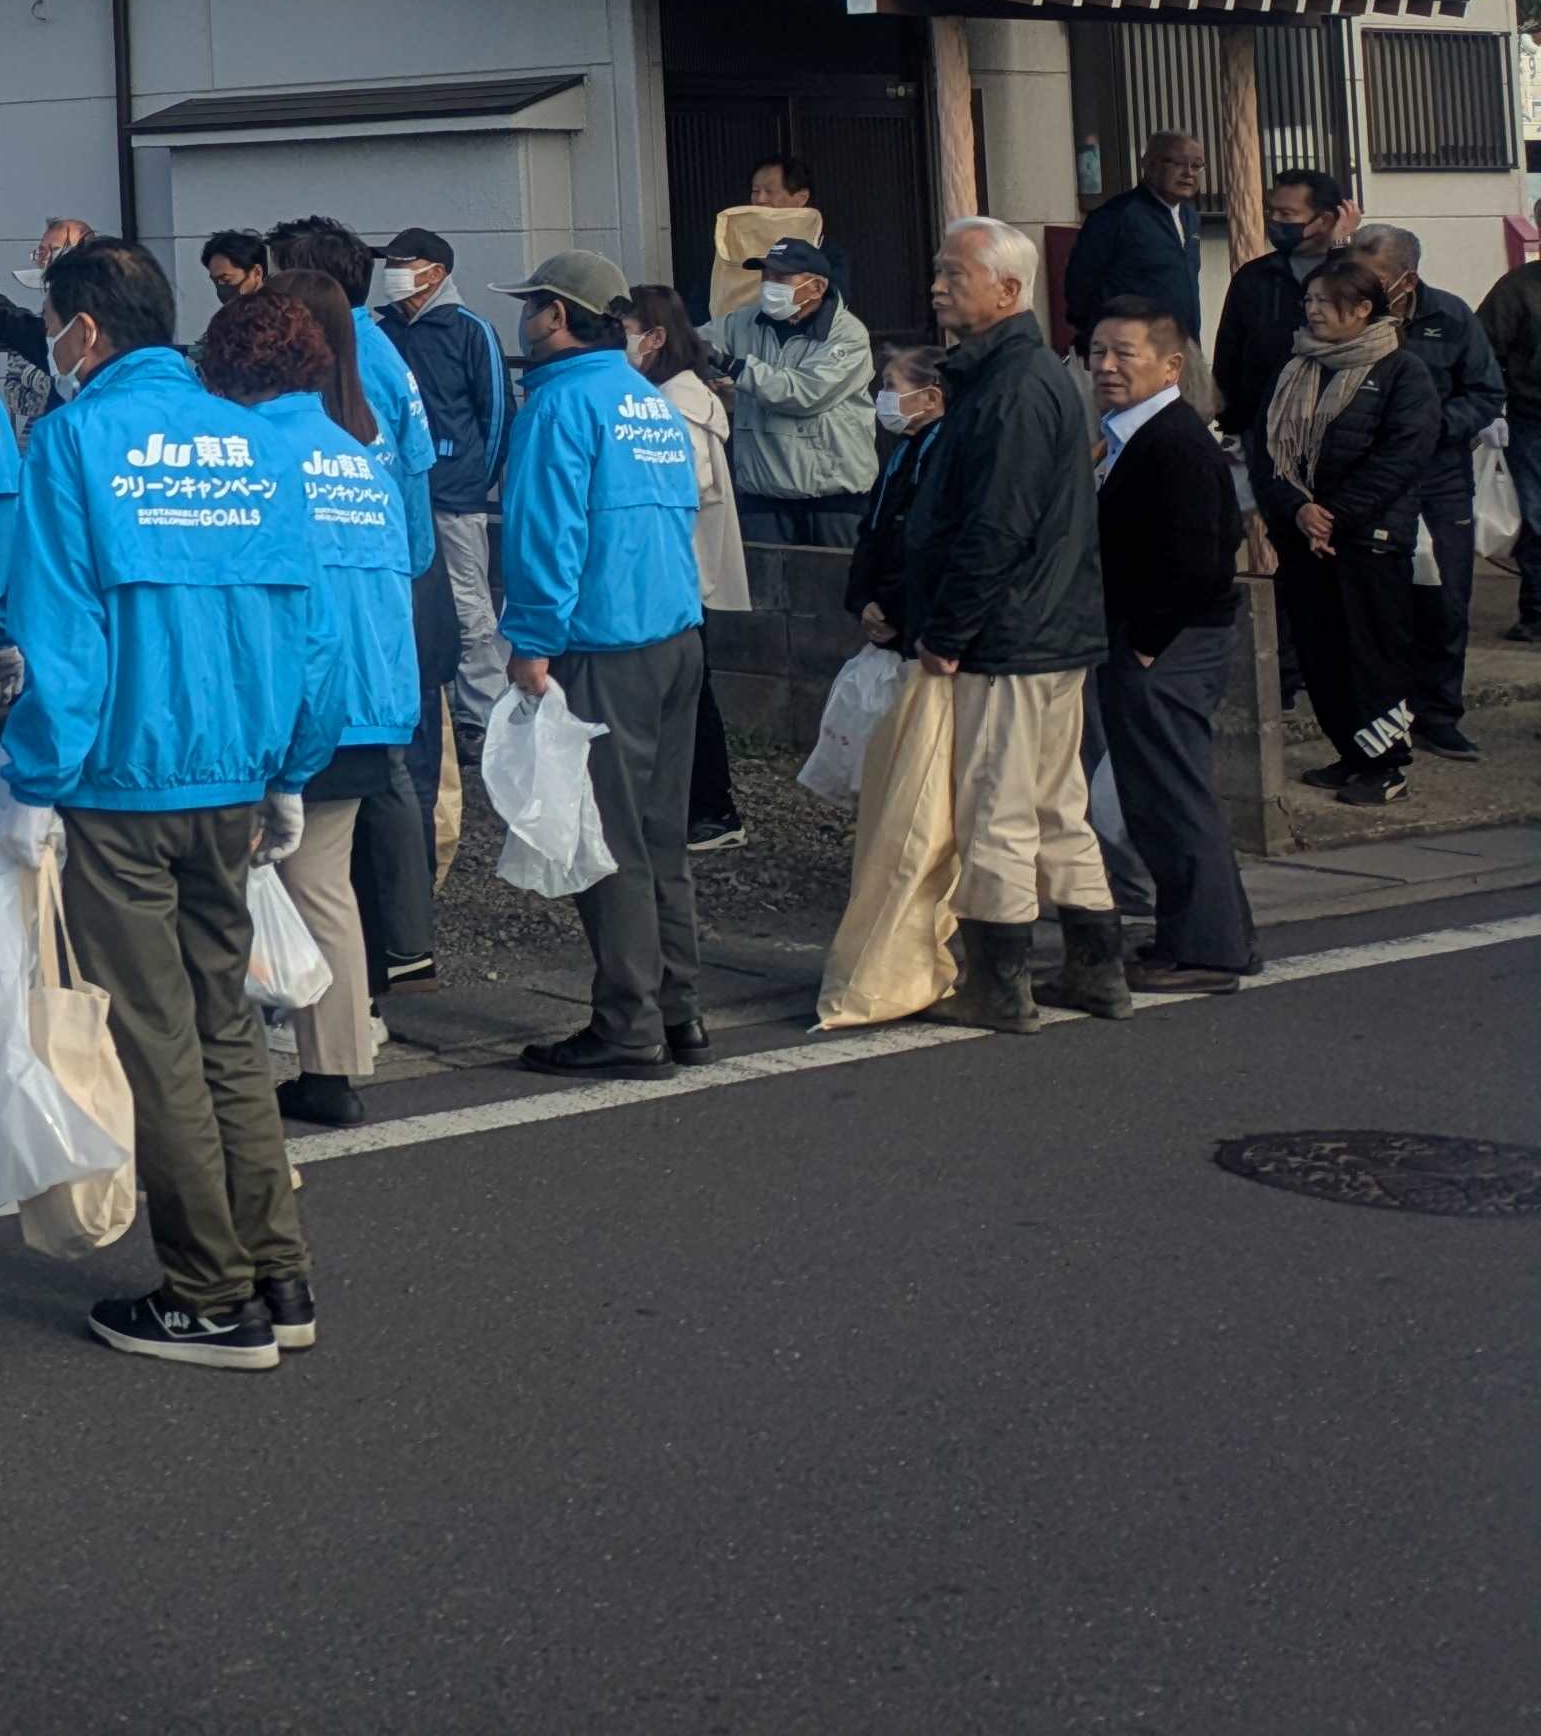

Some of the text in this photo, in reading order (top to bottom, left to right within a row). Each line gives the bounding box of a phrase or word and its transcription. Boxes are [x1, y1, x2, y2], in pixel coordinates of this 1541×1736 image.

[111, 475, 277, 499] クリーンキャンペーン
[199, 508, 261, 526] GOALS
